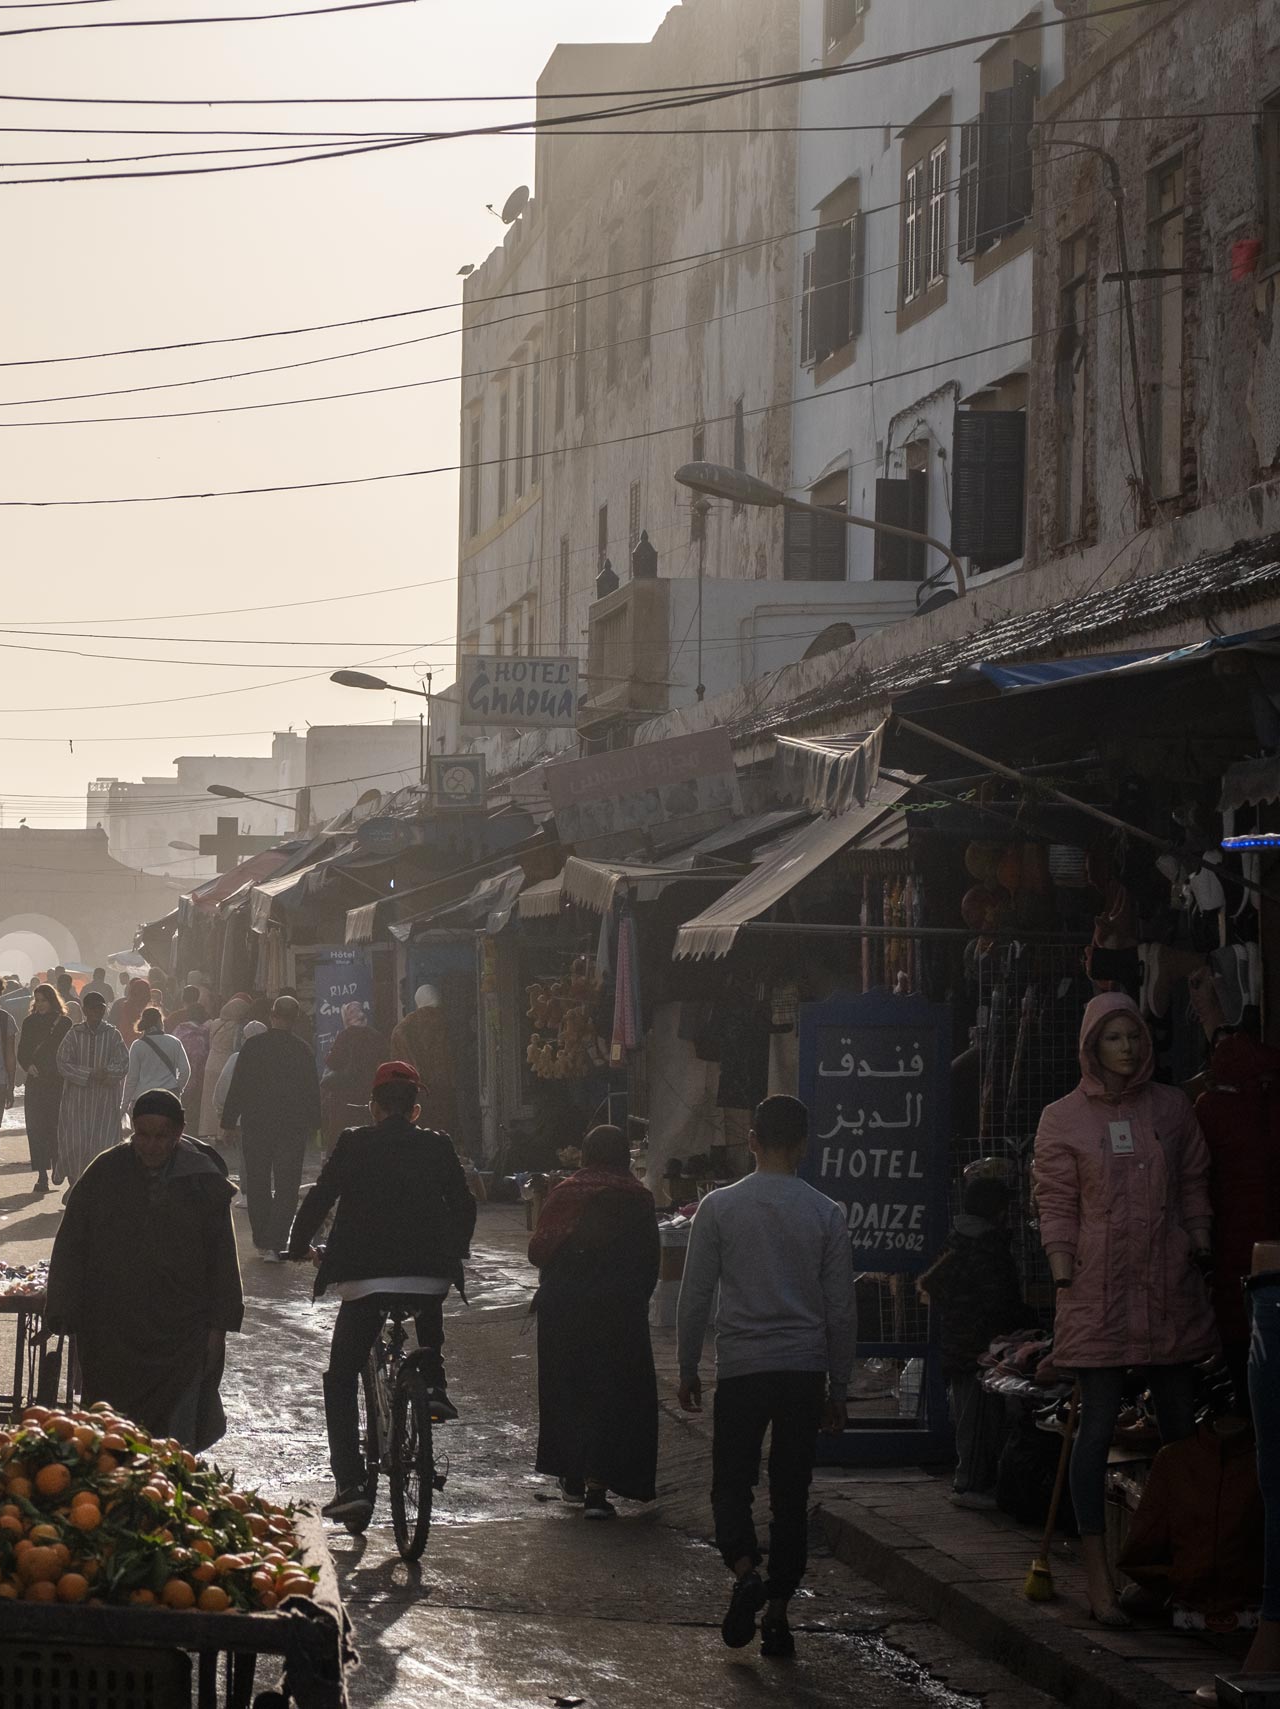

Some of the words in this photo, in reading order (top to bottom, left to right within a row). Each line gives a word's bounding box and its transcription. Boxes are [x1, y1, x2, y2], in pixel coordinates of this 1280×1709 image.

[494, 661, 570, 684] HOTEL
[329, 982, 358, 998] RIAD
[818, 1036, 925, 1078] فندق
[816, 1090, 924, 1139] الديز
[820, 1146, 925, 1179] HOTEL
[836, 1201, 927, 1230] DAIZE
